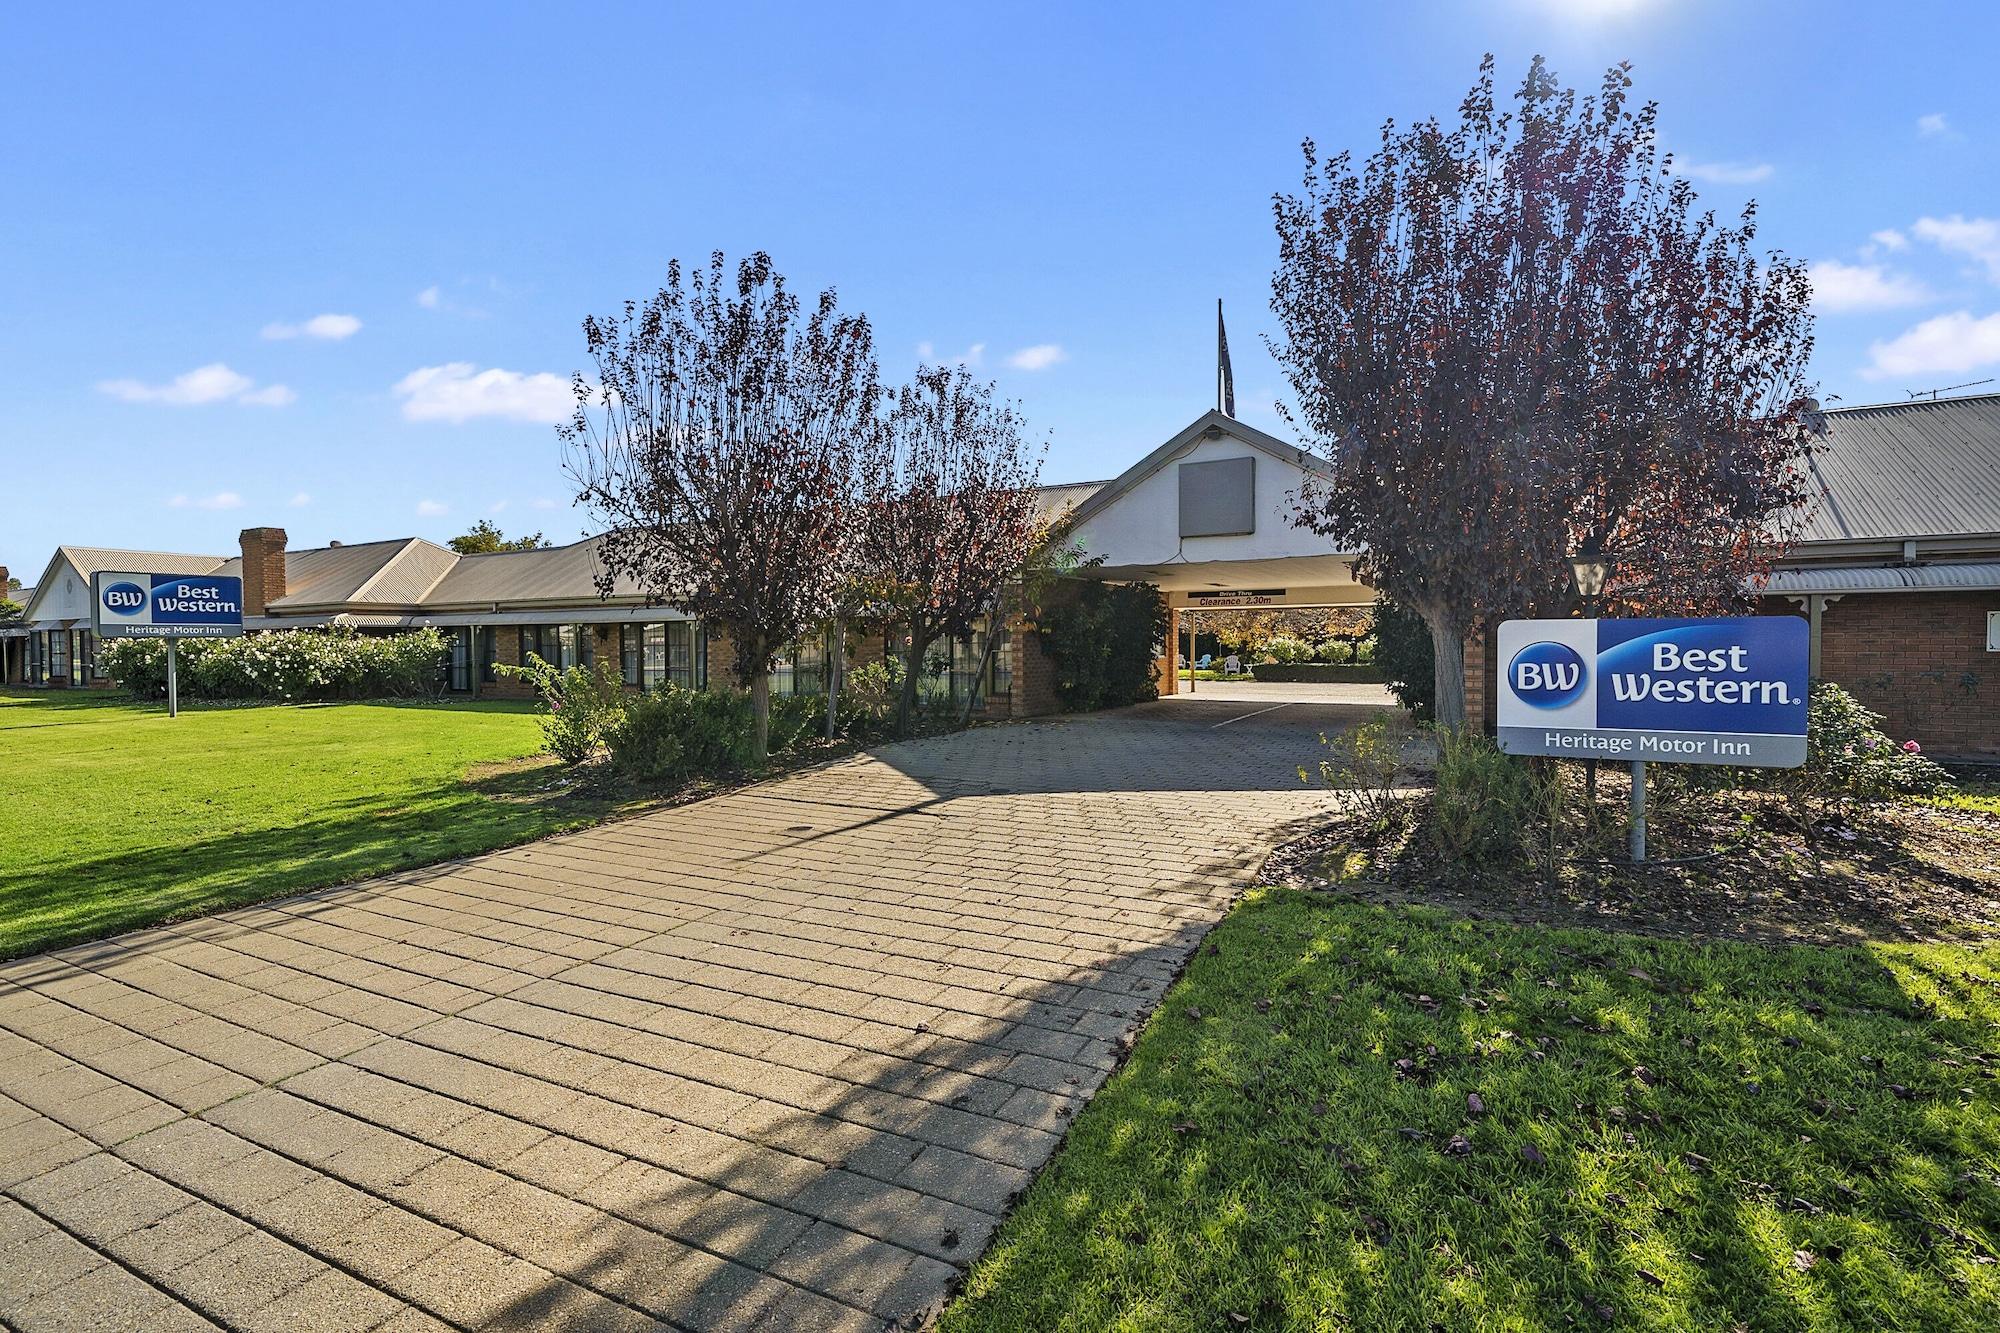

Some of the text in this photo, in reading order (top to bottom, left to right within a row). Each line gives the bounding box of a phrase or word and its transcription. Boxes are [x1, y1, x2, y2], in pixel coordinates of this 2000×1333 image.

[107, 591, 143, 606] BW
[177, 584, 219, 599] Best
[158, 597, 235, 613] Western
[1200, 596, 1272, 606] Clearance 2.30m
[125, 626, 171, 635] Heritage
[173, 626, 203, 634] Motor
[1652, 642, 1748, 673] Best
[1517, 662, 1580, 691] BW
[1545, 732, 1751, 756] Heritage Motor Inn
